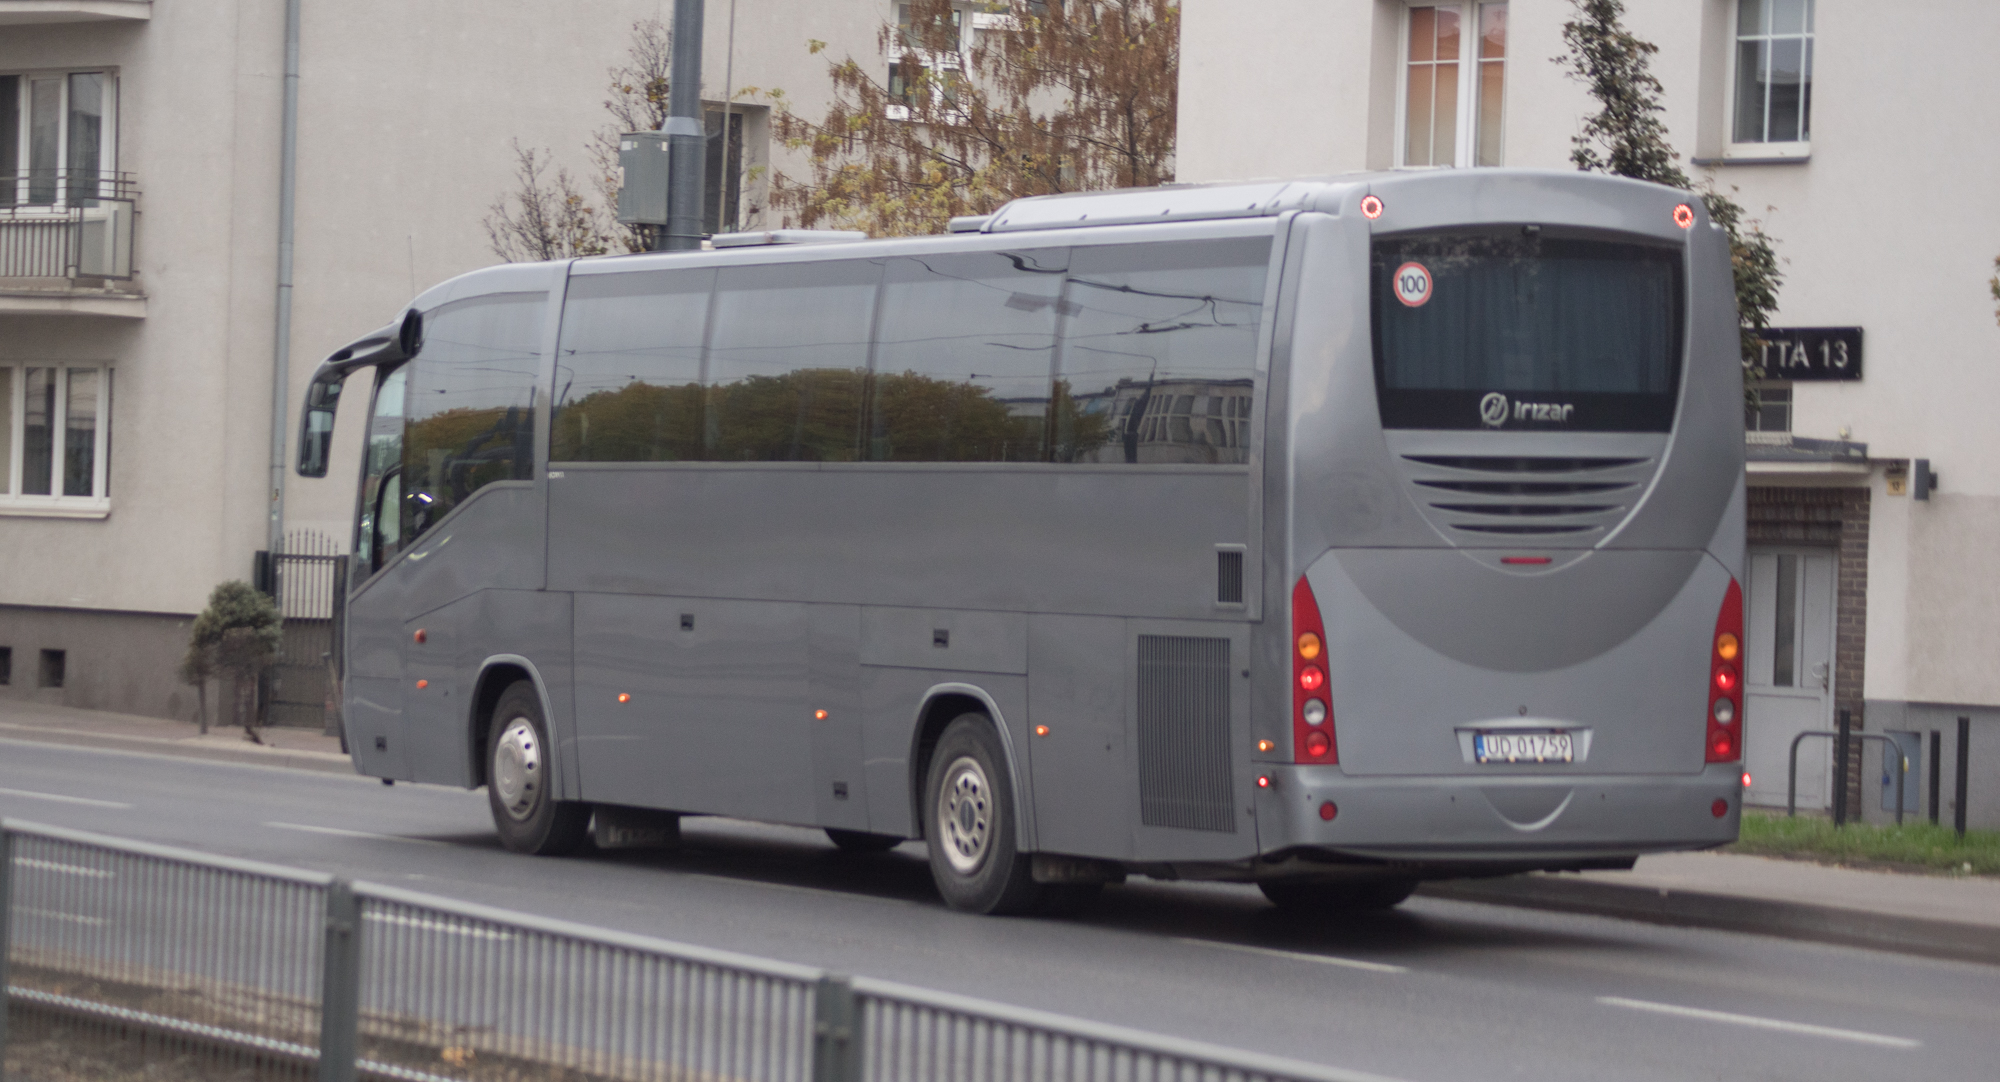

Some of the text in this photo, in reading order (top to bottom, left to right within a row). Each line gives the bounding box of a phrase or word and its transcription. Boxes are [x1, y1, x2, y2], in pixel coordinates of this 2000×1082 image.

[1400, 275, 1426, 293] 100
[1820, 340, 1849, 368] 13
[1487, 735, 1569, 756] UD 01759
